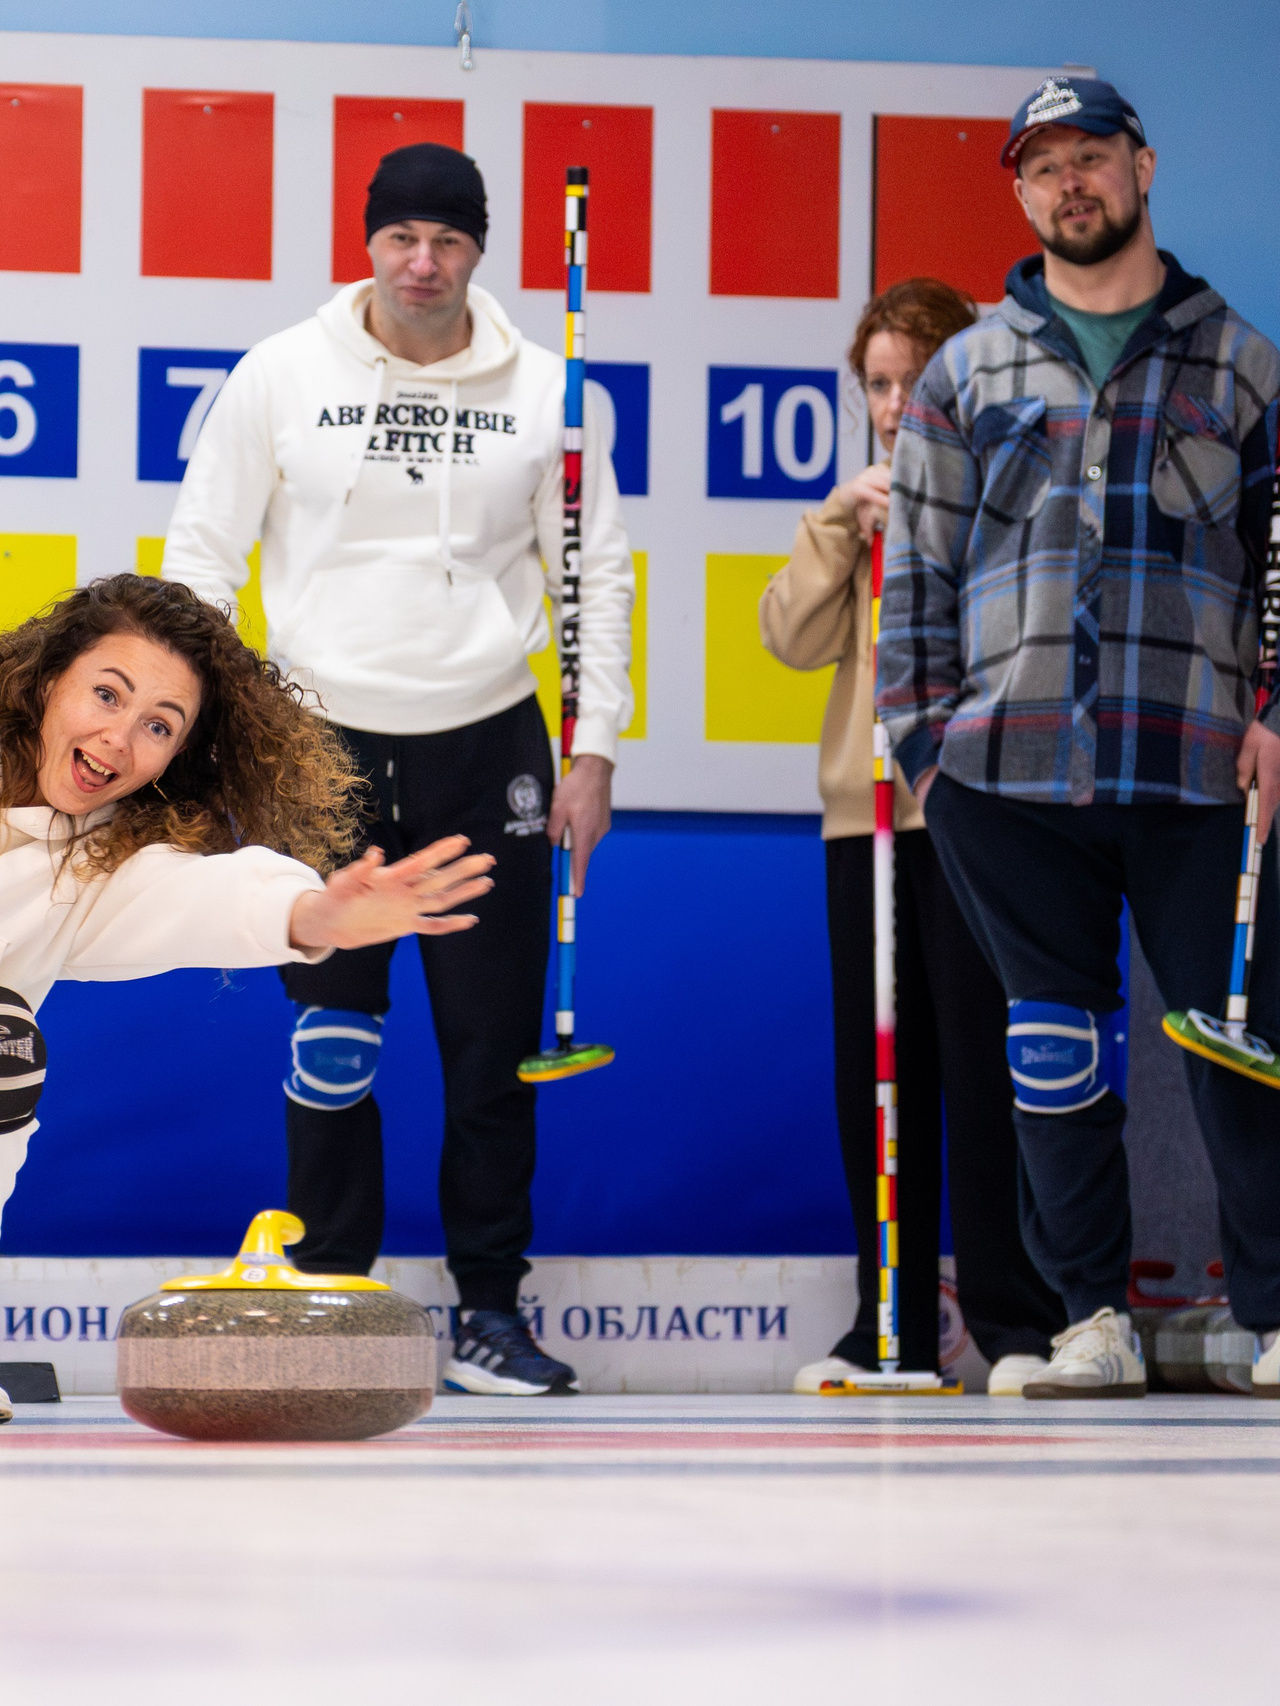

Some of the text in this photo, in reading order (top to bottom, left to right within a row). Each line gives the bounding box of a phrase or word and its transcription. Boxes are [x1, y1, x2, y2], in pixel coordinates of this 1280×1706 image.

[165, 366, 229, 461] 7
[720, 382, 835, 482] 10
[561, 1305, 790, 1341] ОБЛАСТИ
